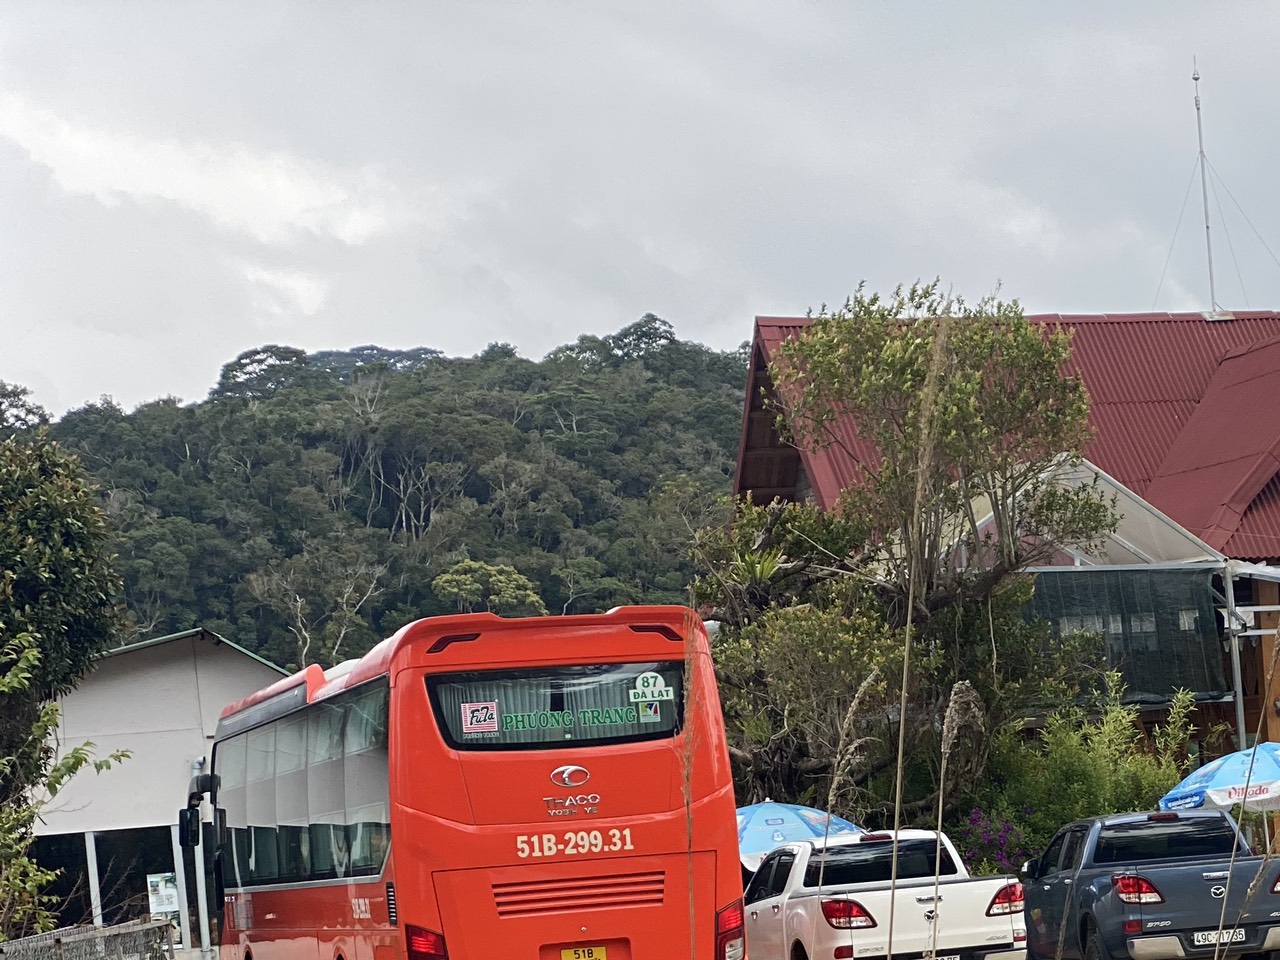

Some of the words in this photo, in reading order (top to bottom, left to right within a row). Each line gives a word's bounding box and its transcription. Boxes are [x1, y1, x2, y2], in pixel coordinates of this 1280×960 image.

[642, 676, 659, 688] 87
[633, 689, 647, 699] ĐÀ
[651, 689, 670, 700] LẠT
[502, 709, 574, 731] PHƯƠNG
[579, 707, 638, 726] TRANG
[542, 793, 601, 808] THACO
[516, 828, 634, 858] 51B-299.31
[573, 948, 594, 959] 51B
